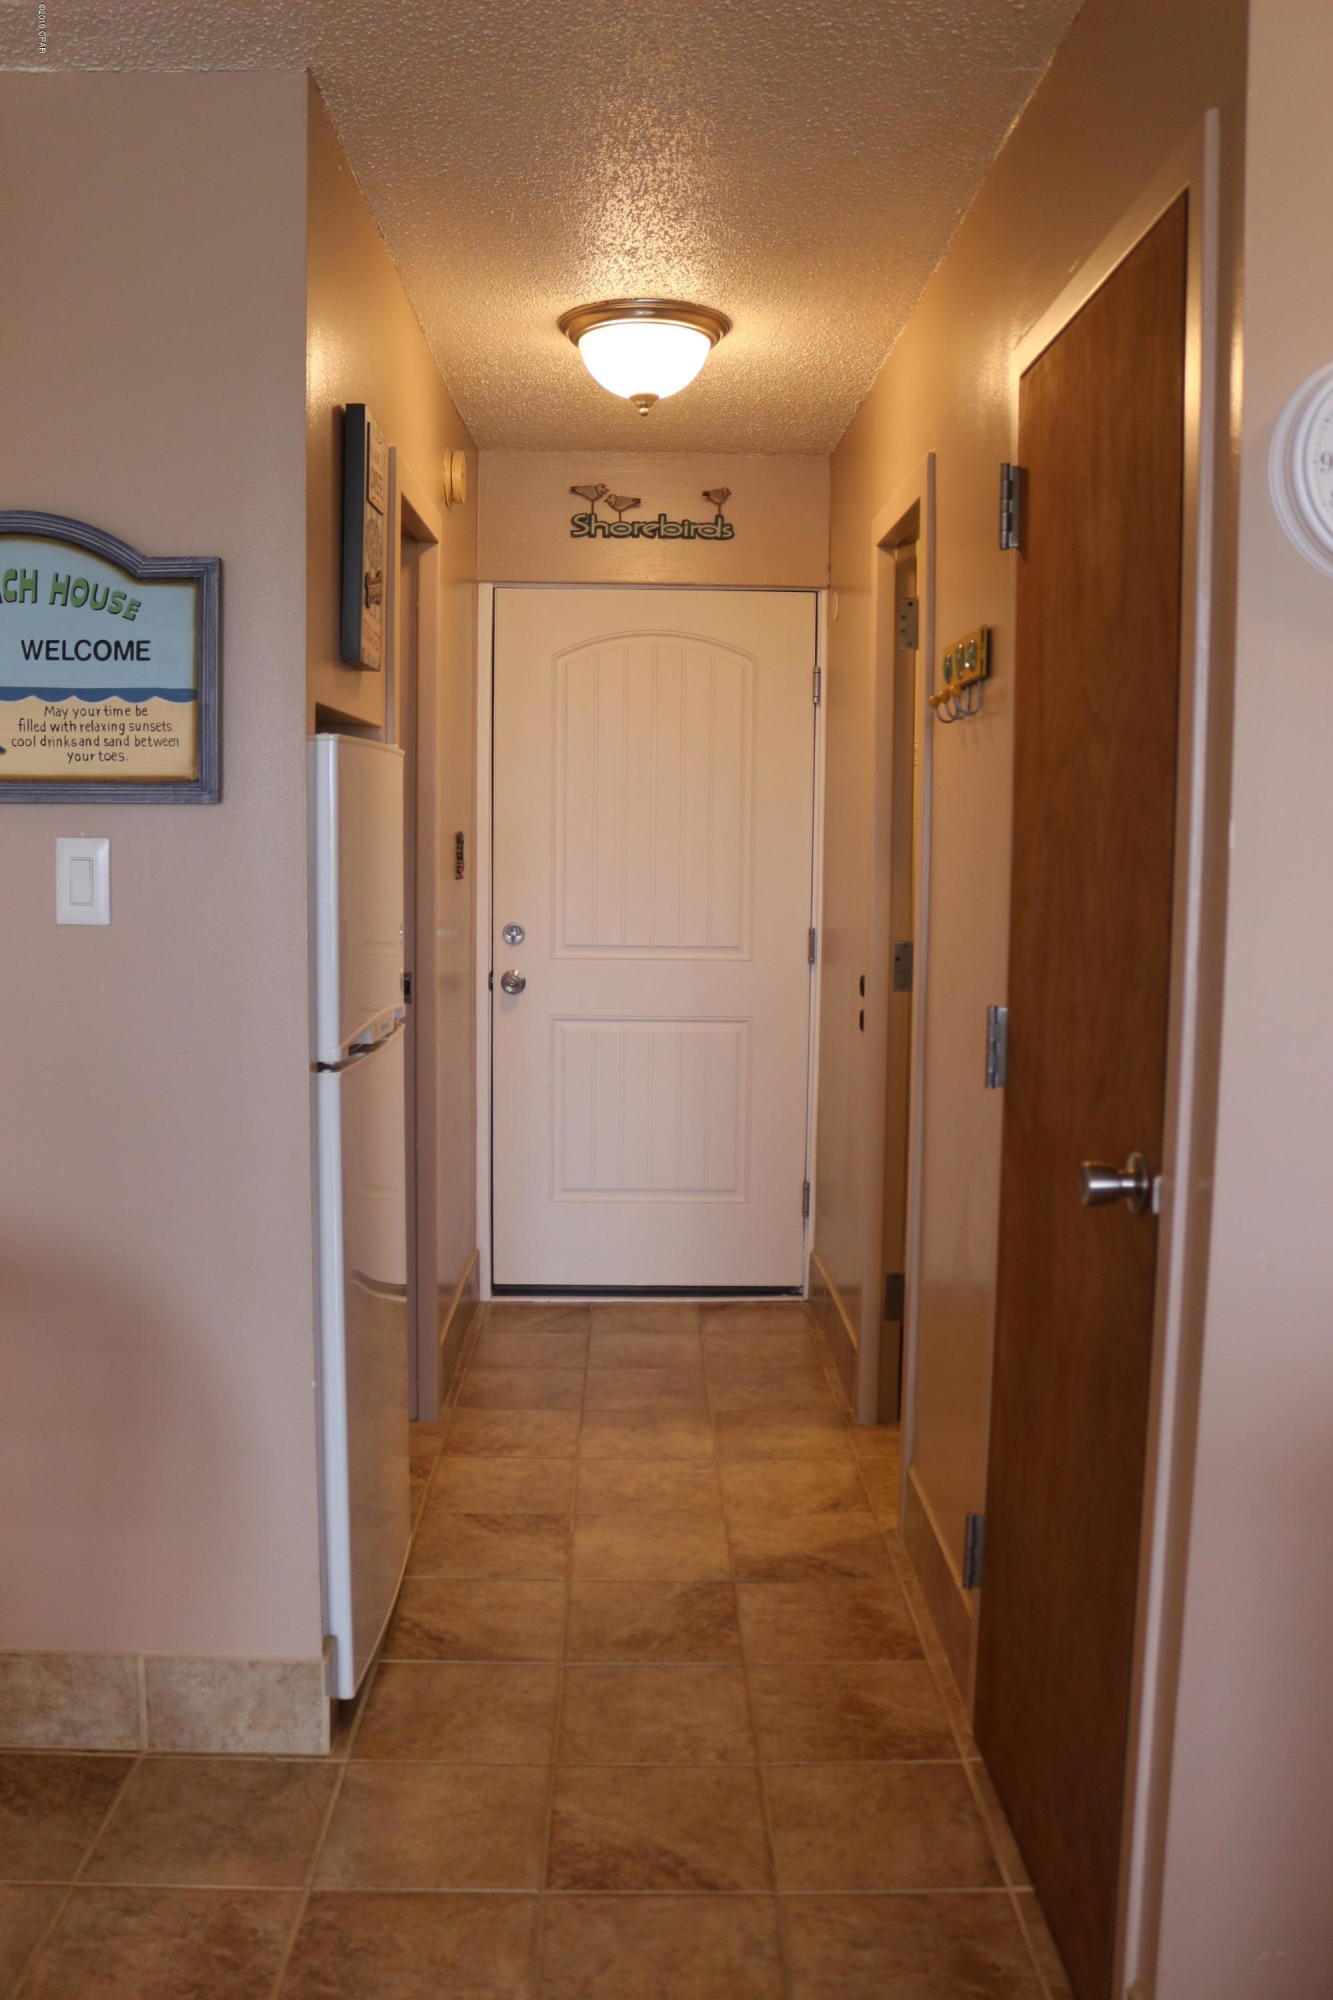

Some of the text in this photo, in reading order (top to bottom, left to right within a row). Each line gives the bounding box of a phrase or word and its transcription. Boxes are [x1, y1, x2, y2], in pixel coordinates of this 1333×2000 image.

[570, 513, 735, 540] Shorebirds
[0, 568, 142, 621] CH HOUSE
[21, 639, 151, 661] WELCOME
[44, 705, 149, 719] May your time be
[18, 718, 173, 736] filled with relaxing sunsets
[11, 735, 180, 748] cool drinks and sand between
[67, 751, 129, 765] your toes.
